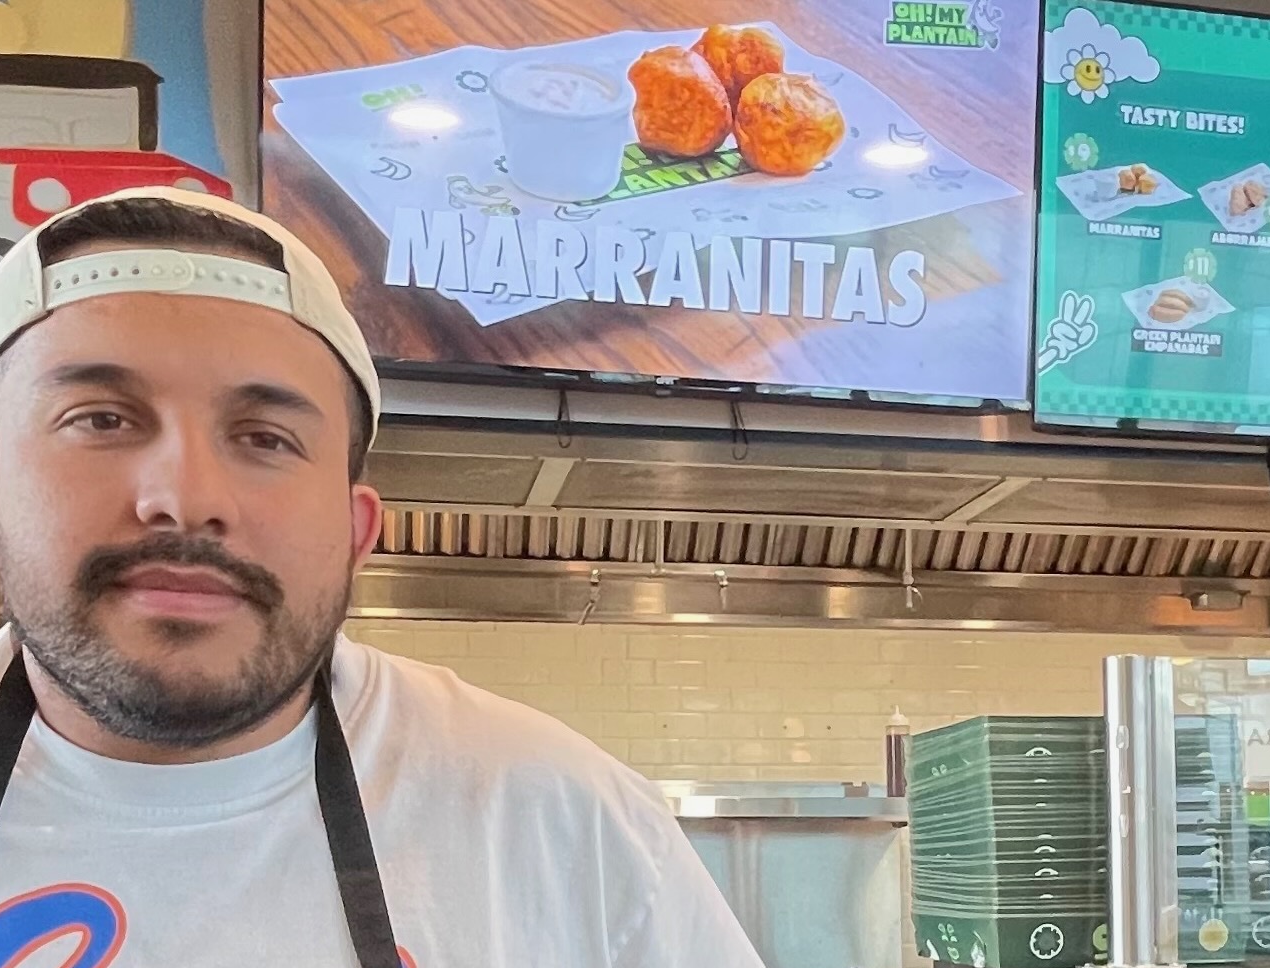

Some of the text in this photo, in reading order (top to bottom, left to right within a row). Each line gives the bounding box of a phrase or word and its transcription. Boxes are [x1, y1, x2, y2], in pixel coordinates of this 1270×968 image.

[894, 3, 967, 24] OH! MY
[888, 23, 977, 46] PLANTAIN
[1120, 104, 1246, 135] TASTY BITES!
[1088, 221, 1161, 240] MARRANITAS
[385, 208, 927, 327] MARRANITAS
[1133, 329, 1221, 346] GREEN PLANTAIN
[1144, 341, 1210, 356] EMPANADAS
